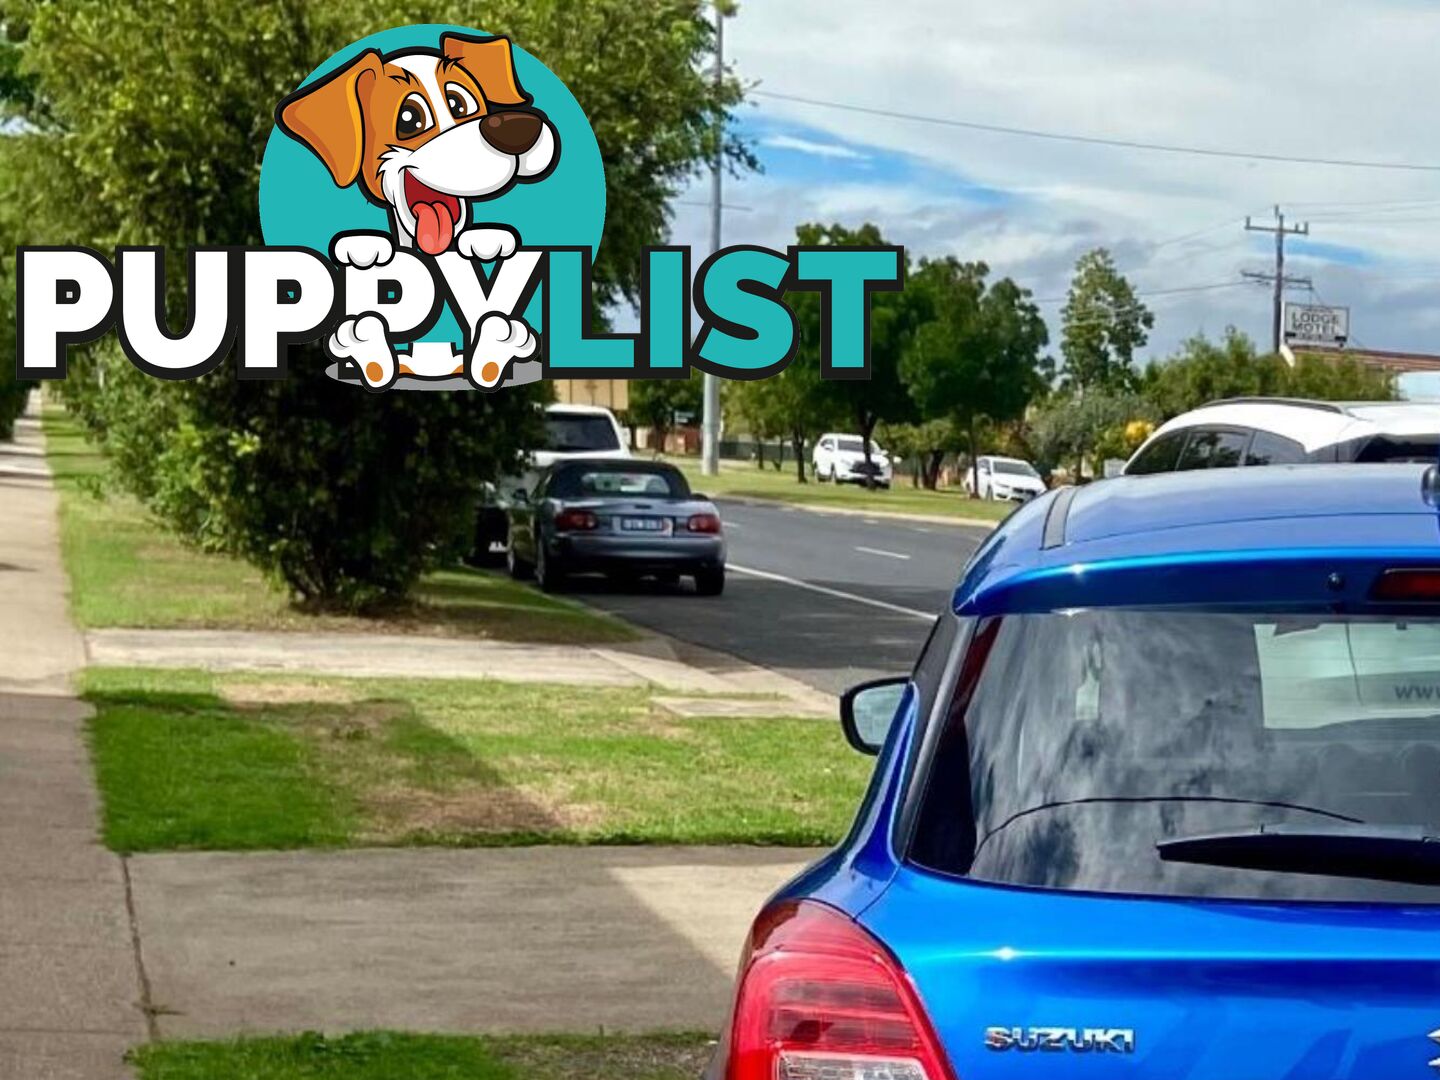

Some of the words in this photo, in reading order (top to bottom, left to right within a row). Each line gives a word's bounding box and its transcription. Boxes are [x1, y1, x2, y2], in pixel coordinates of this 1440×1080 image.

[1291, 311, 1339, 325] LODGE
[1291, 322, 1338, 335] MOTEL
[984, 1026, 1134, 1052] SUZUKI
